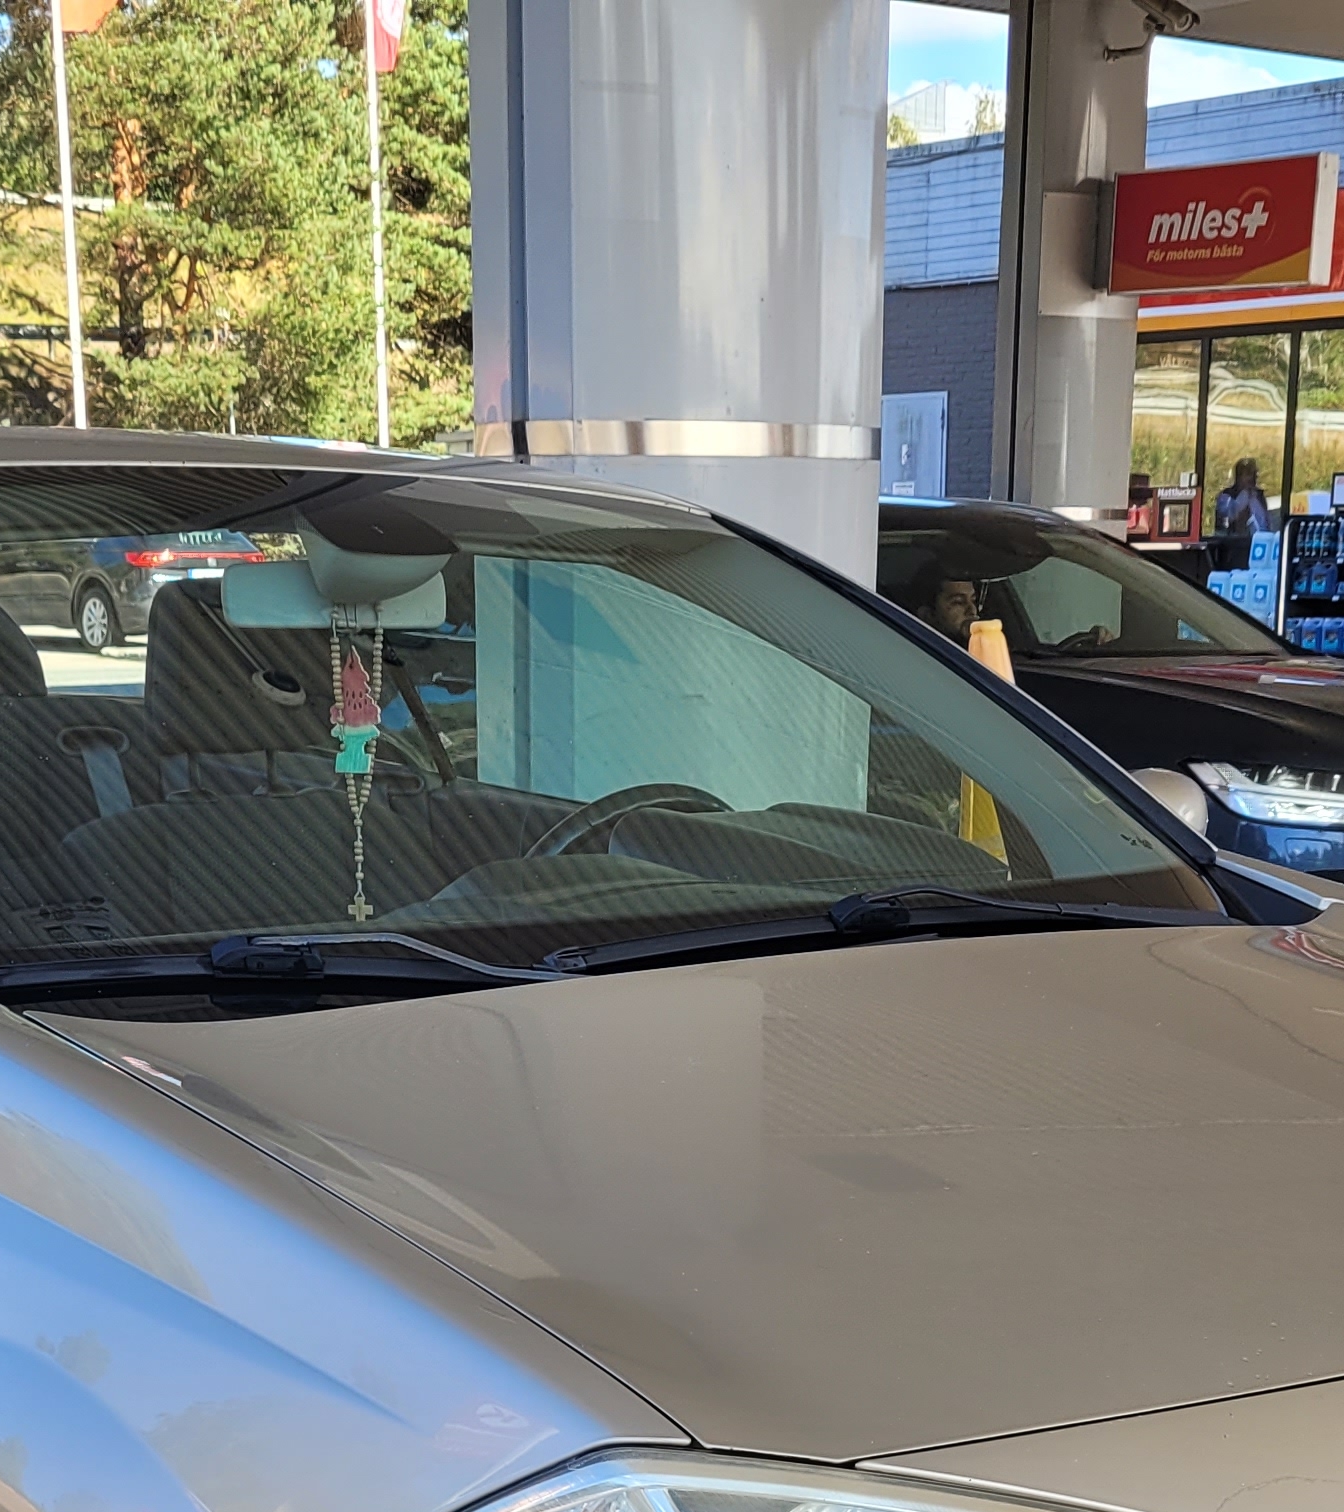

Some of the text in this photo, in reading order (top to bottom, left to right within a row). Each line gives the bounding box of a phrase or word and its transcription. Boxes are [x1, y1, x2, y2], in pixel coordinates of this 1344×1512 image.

[1147, 200, 1270, 244] miles+
[1146, 244, 1244, 264] För motorns bästa
